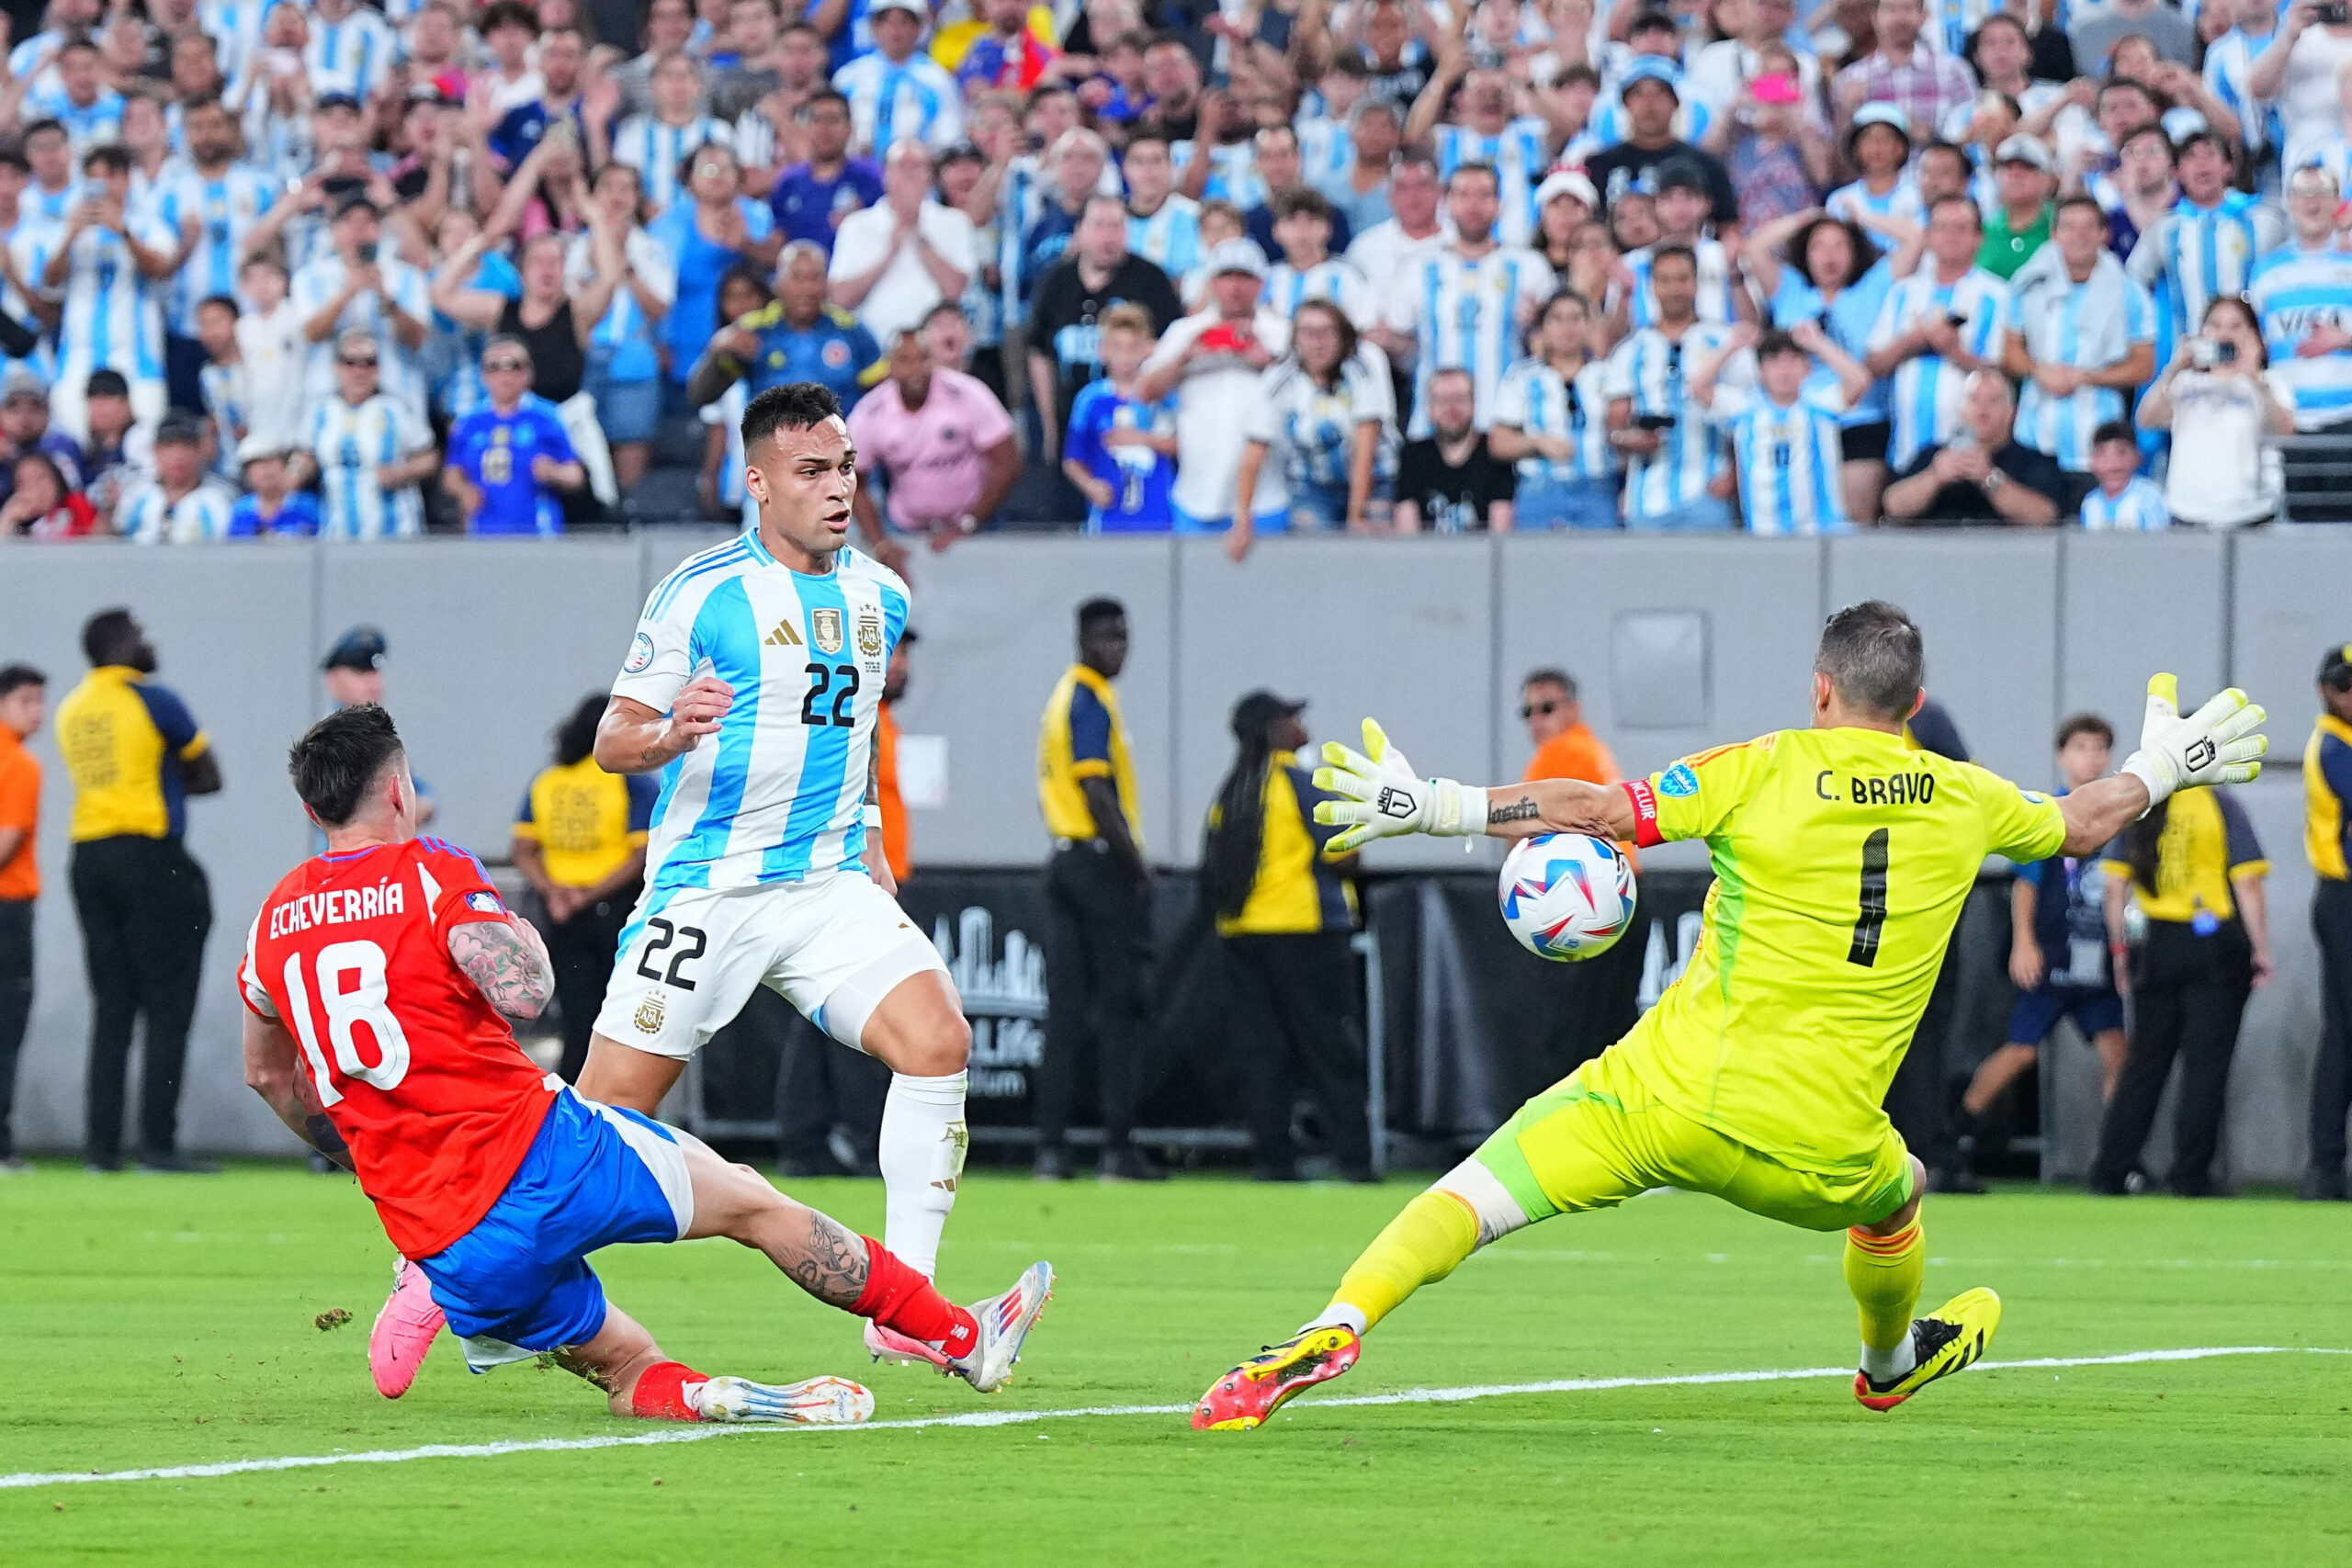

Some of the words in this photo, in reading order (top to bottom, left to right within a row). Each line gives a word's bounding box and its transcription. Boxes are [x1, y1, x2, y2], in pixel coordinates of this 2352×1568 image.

[801, 663, 859, 728] 22
[1816, 770, 1840, 801] C.
[1851, 773, 1935, 805] BRAVO
[269, 875, 404, 940] ECHEVERRÍA
[1847, 827, 1889, 968] 1
[637, 917, 707, 991] 22
[283, 939, 411, 1108] 18
